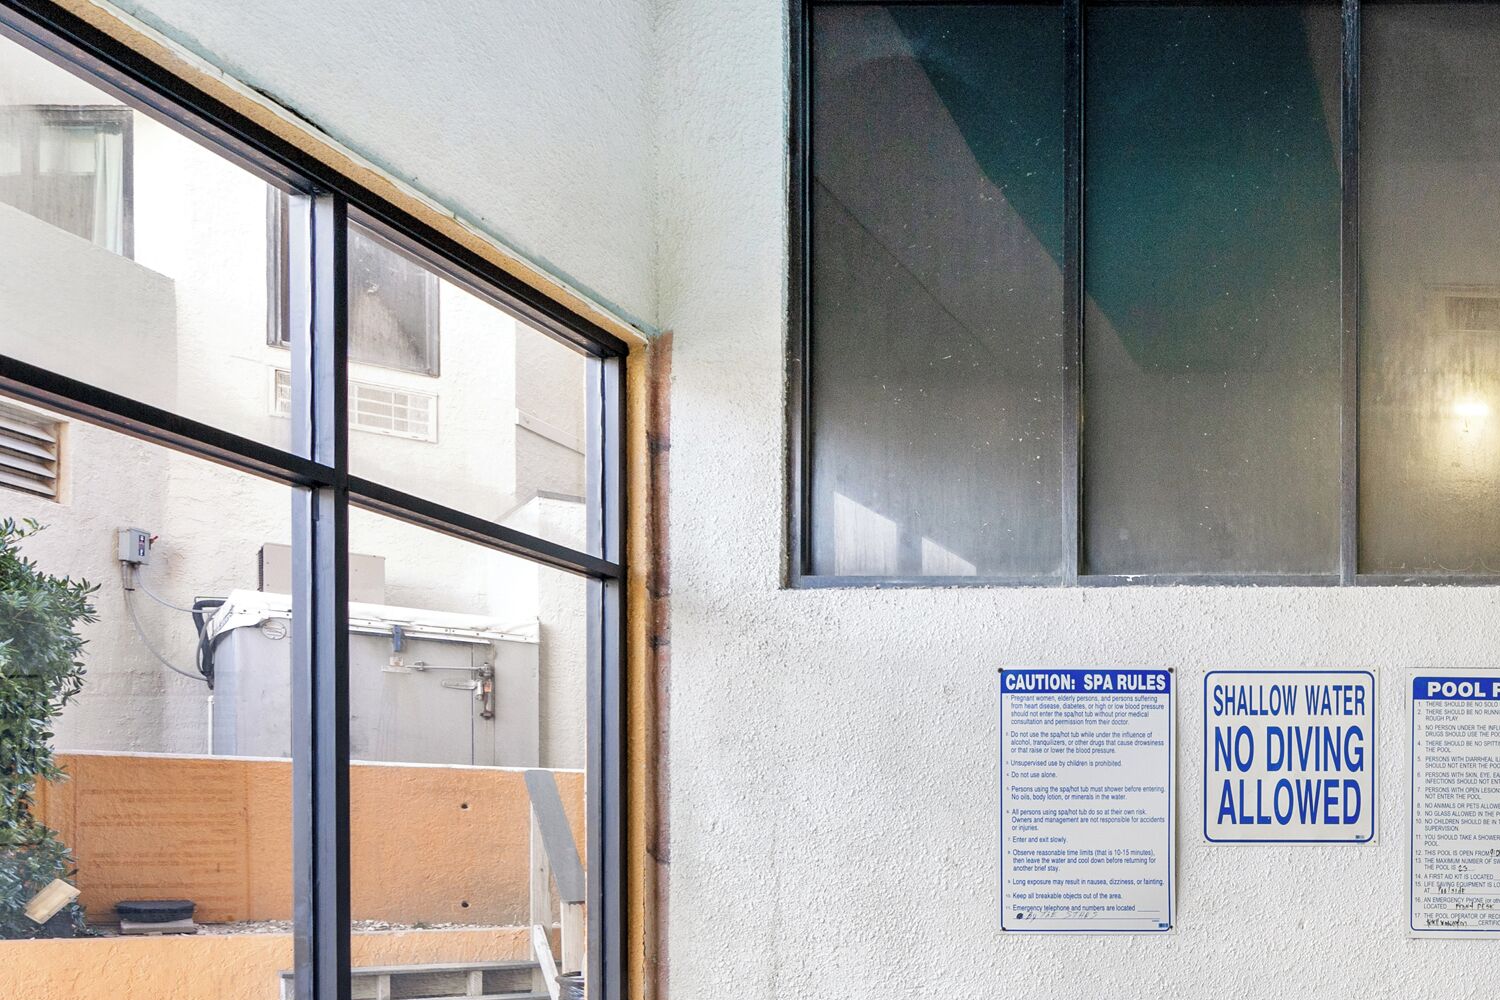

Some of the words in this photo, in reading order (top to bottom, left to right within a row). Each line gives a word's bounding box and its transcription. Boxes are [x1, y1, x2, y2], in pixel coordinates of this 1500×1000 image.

[1006, 674, 1076, 690] CAUTION:
[1084, 674, 1113, 690] SPA
[1117, 674, 1166, 690] RULES
[1428, 682, 1486, 698] POOL
[1214, 684, 1298, 716] SHALLOW
[1305, 685, 1365, 716] WATER
[1214, 725, 1254, 772] NO
[1266, 725, 1364, 772] DIVING
[1217, 778, 1362, 825] ALLOWED
